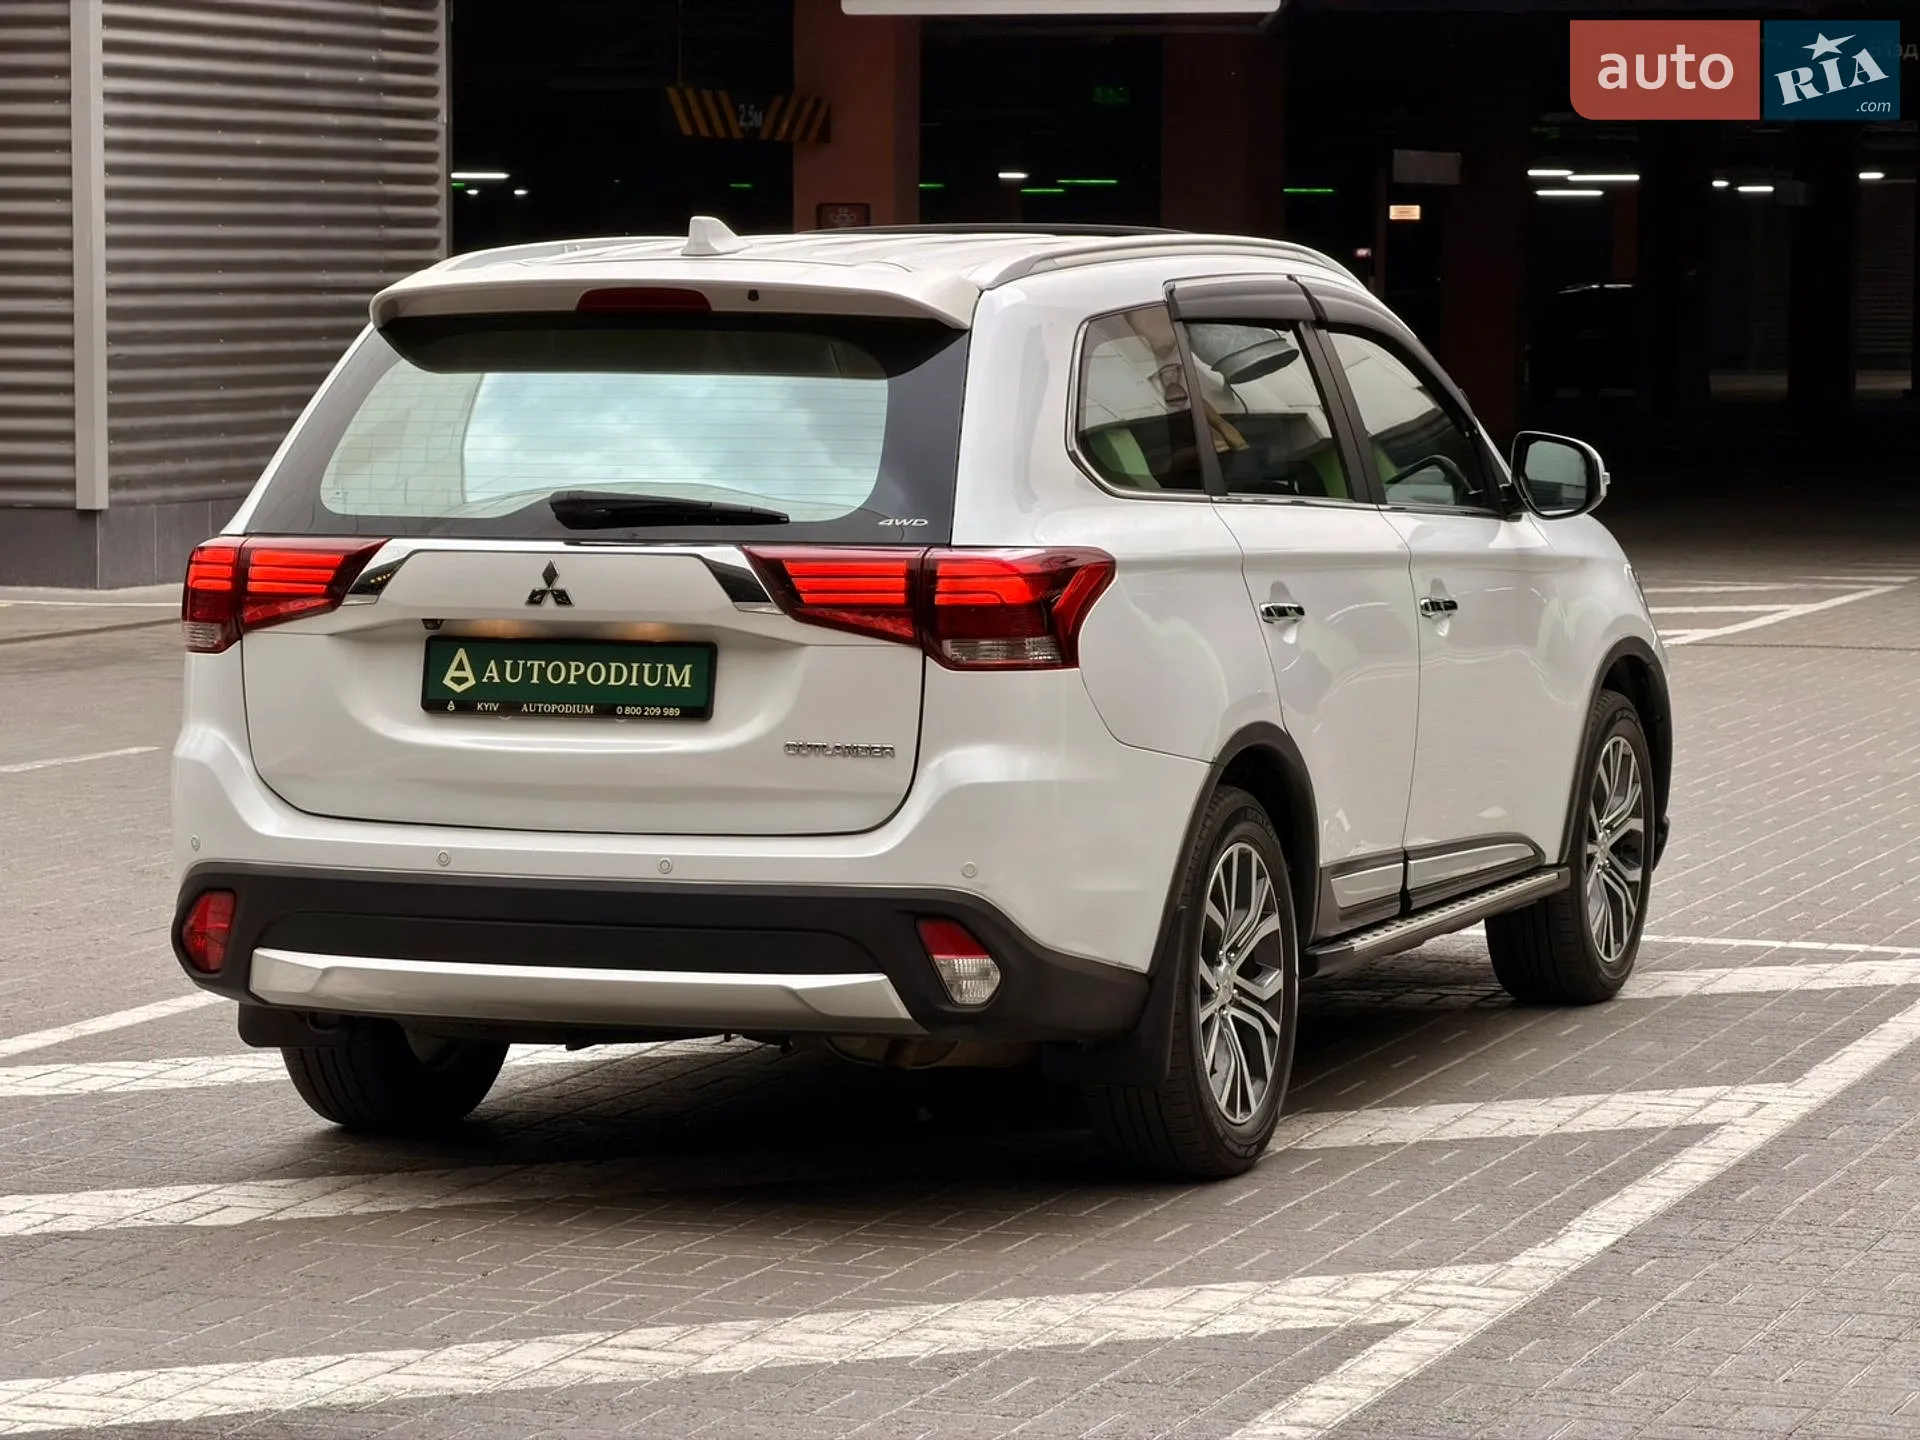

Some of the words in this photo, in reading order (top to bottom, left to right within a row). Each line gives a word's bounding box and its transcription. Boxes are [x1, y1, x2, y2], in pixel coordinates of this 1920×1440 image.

[878, 517, 929, 527] 4WD
[482, 660, 693, 688] AUTOPODIUM
[477, 702, 499, 712] KYIV
[521, 703, 594, 714] AUTOPODIUM
[616, 706, 622, 715] 0
[624, 706, 641, 716] 800
[644, 707, 661, 716] 209
[663, 707, 680, 716] 989
[784, 741, 895, 758] OUTLANDER
